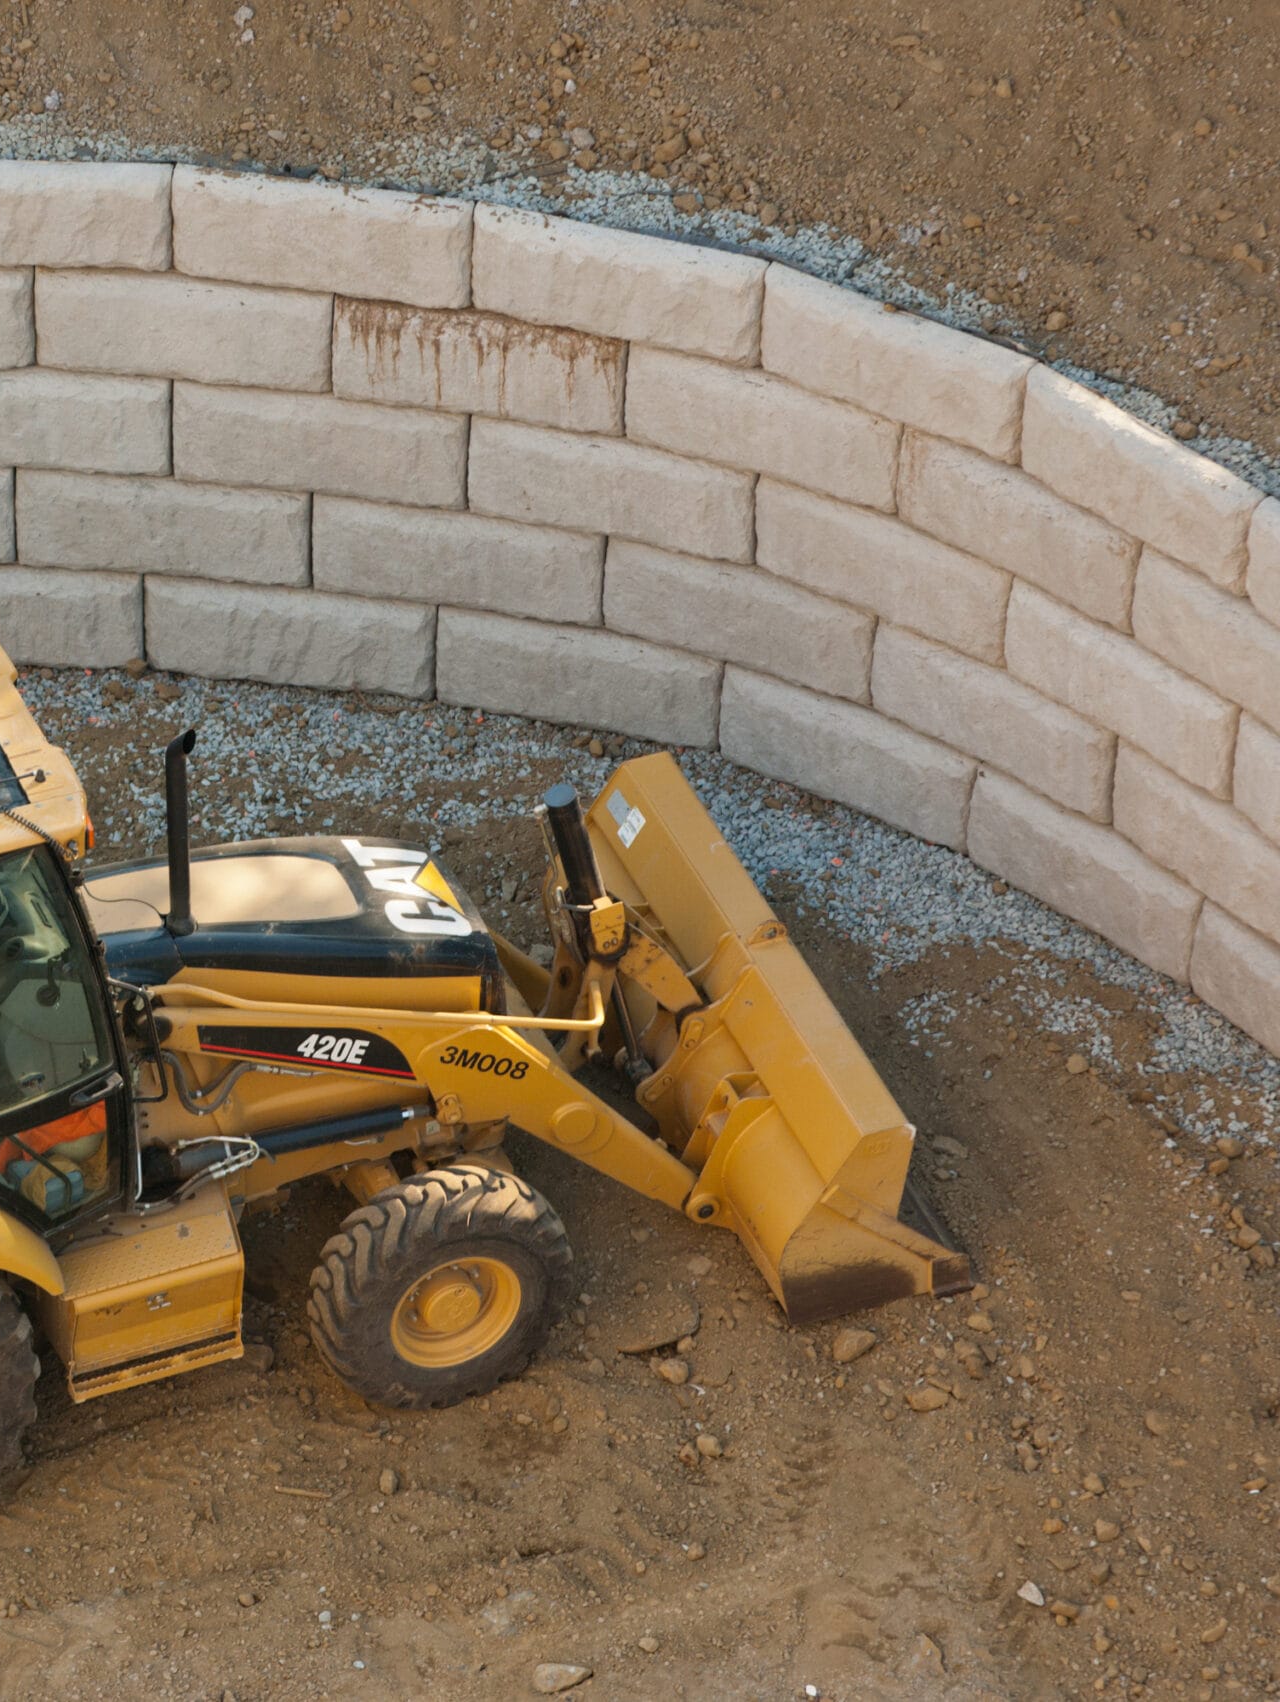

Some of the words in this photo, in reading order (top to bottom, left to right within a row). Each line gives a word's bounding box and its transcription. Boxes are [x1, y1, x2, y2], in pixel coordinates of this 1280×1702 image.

[341, 839, 472, 937] CAT
[297, 1033, 370, 1065] 420E
[439, 1045, 530, 1080] 3M008
